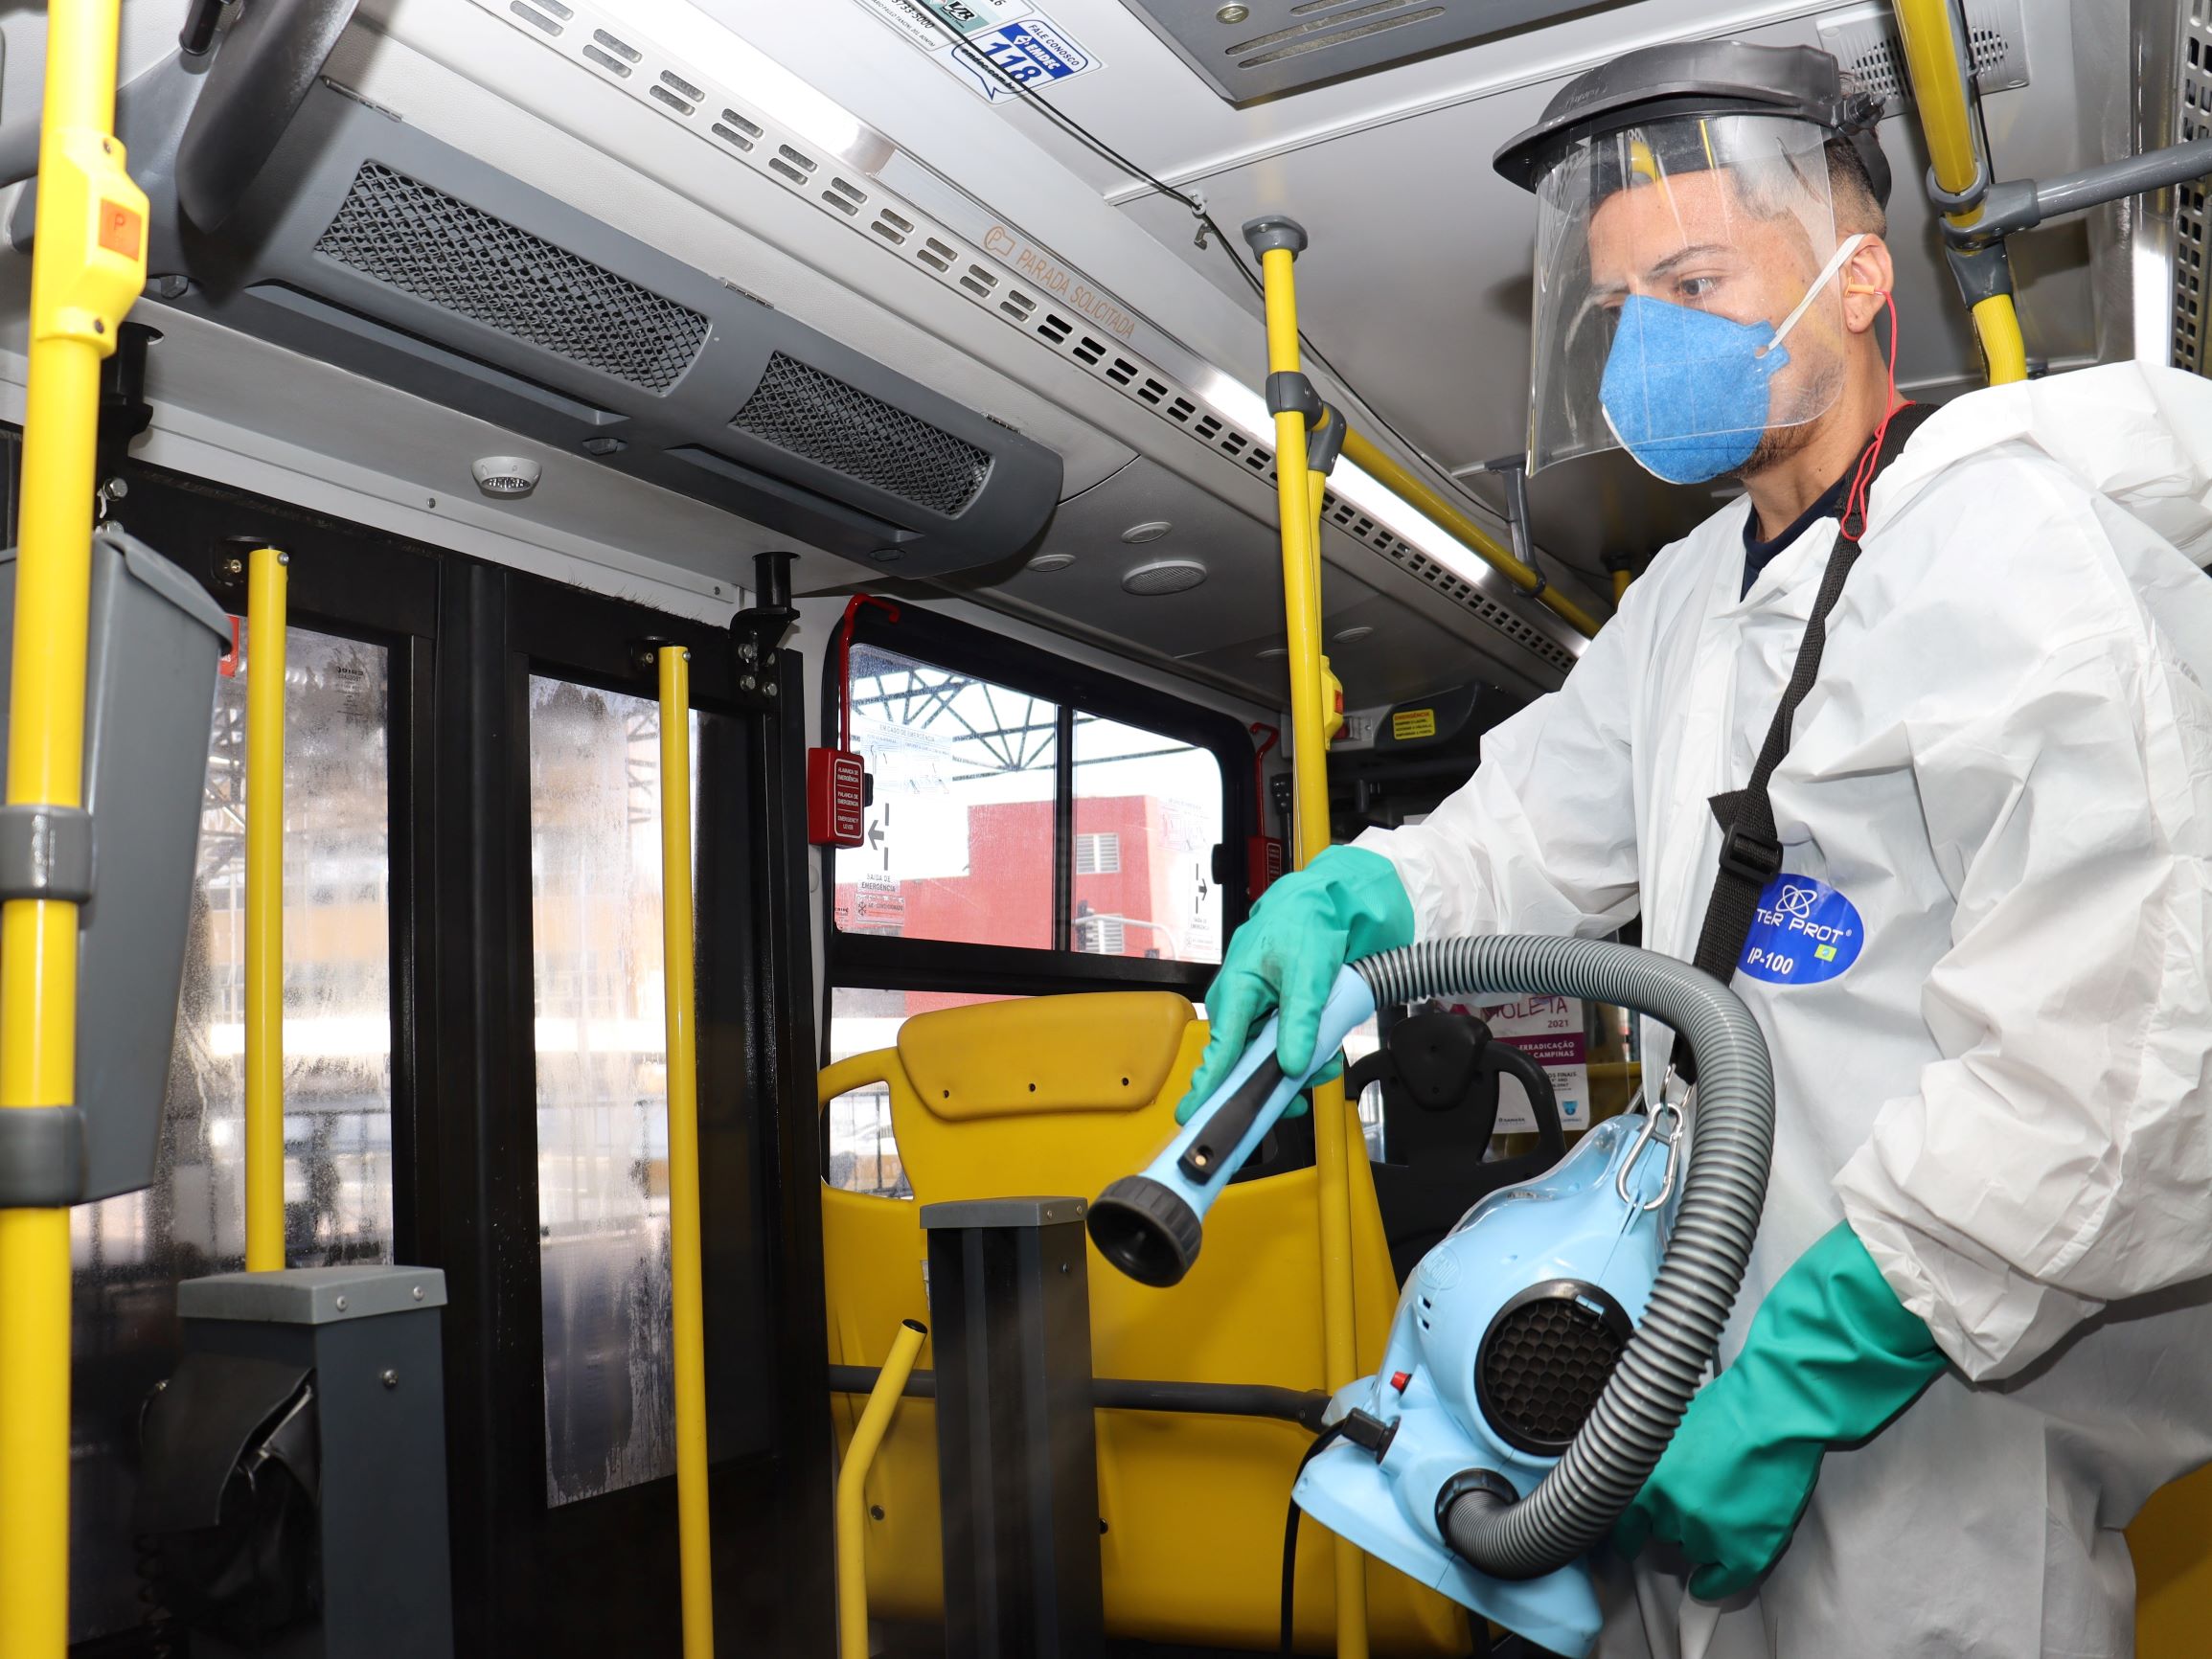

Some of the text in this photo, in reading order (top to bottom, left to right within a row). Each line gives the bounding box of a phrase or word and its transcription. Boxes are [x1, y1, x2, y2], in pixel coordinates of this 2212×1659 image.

[985, 42, 1041, 82] 118
[1026, 42, 1061, 71] EMDEC
[1028, 24, 1080, 67] FALE CONOSCO
[961, 49, 1016, 91] emdec.com.br
[1016, 248, 1071, 296] PARADA
[1069, 285, 1135, 339] SOLICITADA
[1747, 947, 1793, 975] IP-100
[1547, 1019, 1569, 1029] 2021
